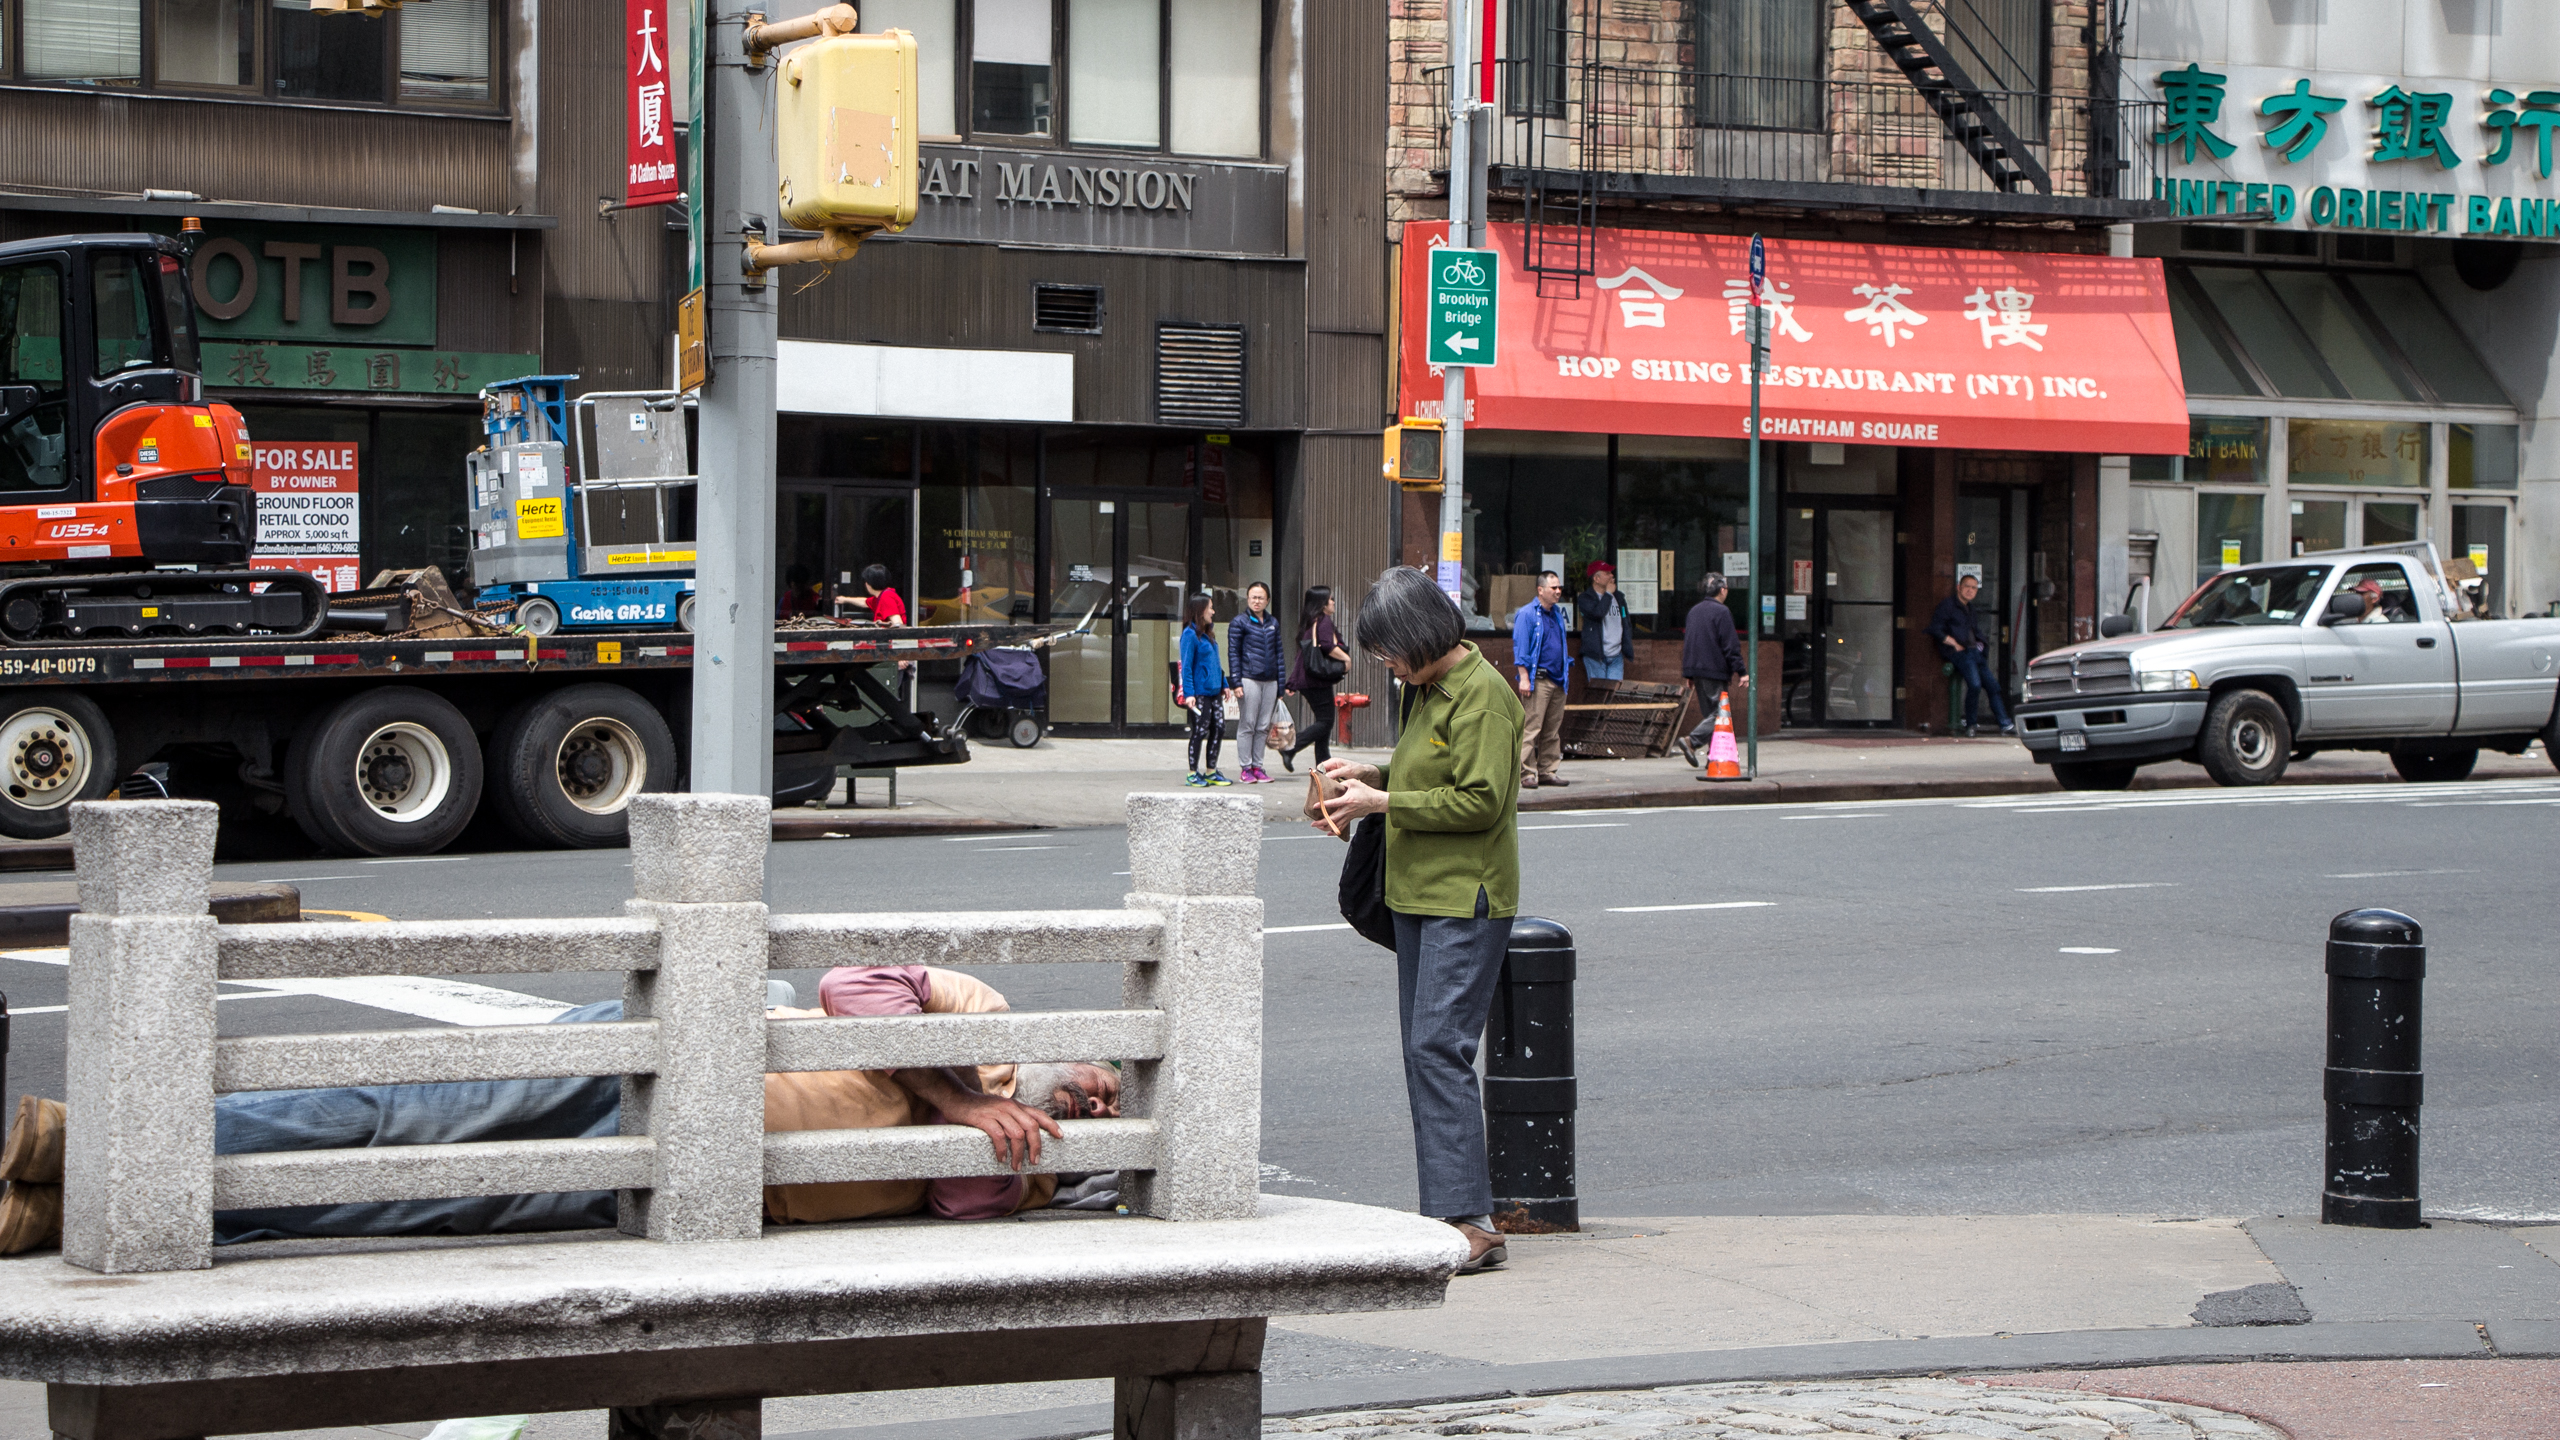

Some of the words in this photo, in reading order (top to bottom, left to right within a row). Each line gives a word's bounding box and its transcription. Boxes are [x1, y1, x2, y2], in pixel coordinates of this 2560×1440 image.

[637, 9, 665, 148] 大廈
[2155, 62, 2560, 180] 東方銀行
[996, 161, 1196, 211] MANSION
[2155, 178, 2296, 223] UNITED
[2311, 186, 2455, 232] ORIENT
[2468, 195, 2560, 238] BANK
[192, 237, 391, 324] OTB
[1439, 292, 1489, 308] Brooklyn
[1596, 266, 2048, 352] 合誠茶樓
[1445, 311, 1481, 326] Bridge
[1557, 355, 1621, 379] HOP
[1631, 359, 1732, 384] SHING
[1966, 374, 2034, 401] (NY)
[2042, 376, 2108, 399] INC.
[1743, 417, 1752, 433] 9
[1761, 418, 1854, 437] CHATHAM
[1862, 422, 1939, 440] SQUARE
[2219, 440, 2259, 459] BANK
[255, 449, 297, 470] FOR
[302, 449, 353, 470] SALE
[271, 476, 287, 488] BY
[290, 476, 337, 488] OWNER
[256, 497, 310, 509] GROUND
[313, 497, 354, 509] FLOOR
[522, 504, 556, 515] Hertz
[260, 514, 300, 525] RETAIL
[303, 514, 349, 525] CONDO
[50, 523, 109, 538] U35-4
[264, 530, 300, 539] APPROX
[305, 530, 329, 540] 5,000
[330, 532, 340, 540] sq
[341, 529, 349, 539] ft
[332, 543, 358, 553] 299-6882
[590, 586, 649, 597] 453-15-0049
[571, 605, 614, 621] Genie
[617, 604, 666, 620] GR-15
